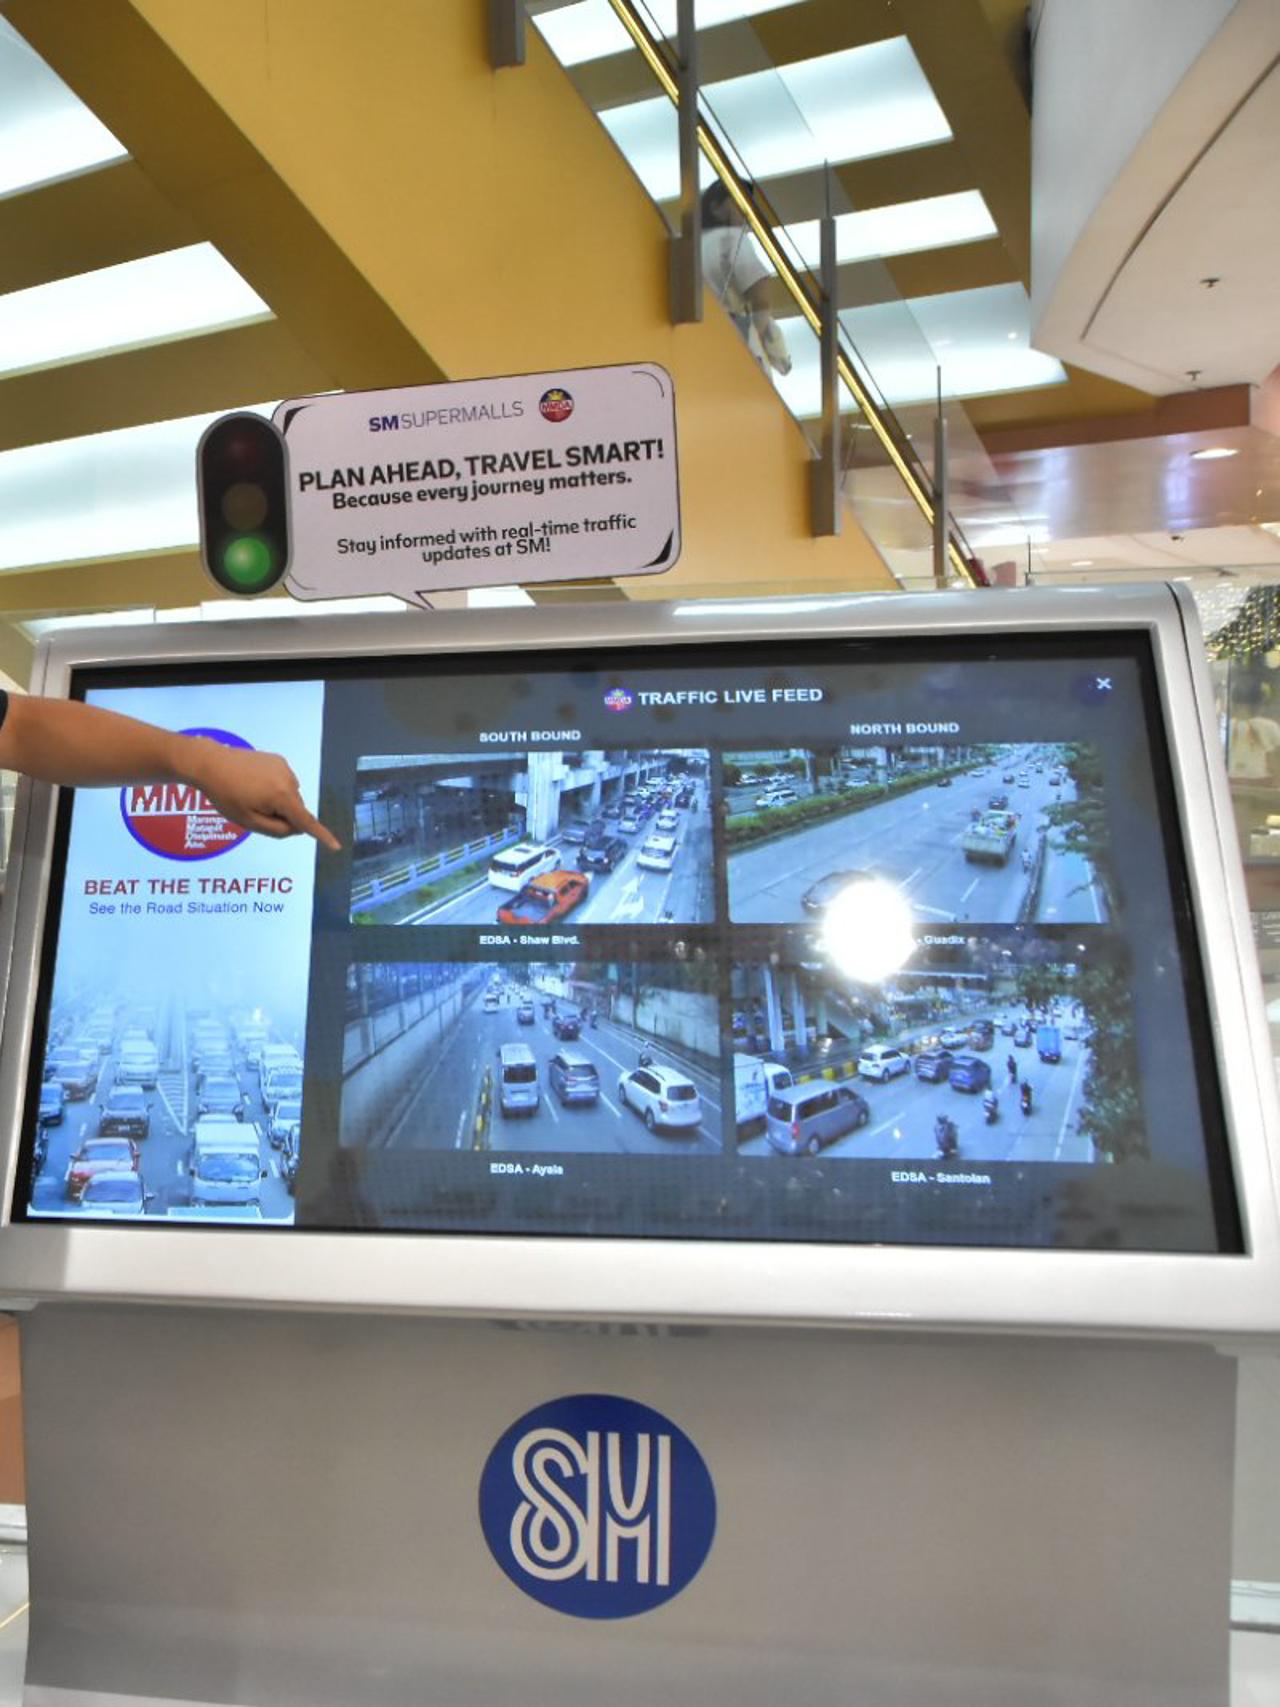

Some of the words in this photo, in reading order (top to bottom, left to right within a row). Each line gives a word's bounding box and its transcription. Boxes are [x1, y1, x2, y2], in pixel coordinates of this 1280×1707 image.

[299, 466, 365, 492] PLAN
[370, 459, 461, 486] AHEAD,
[464, 449, 561, 476] TRAVEL
[565, 438, 664, 467] SMART!
[333, 490, 413, 509] Because
[417, 485, 468, 502] every
[471, 478, 544, 501] journey
[549, 470, 632, 490] matters.
[337, 538, 376, 555] Stay
[380, 529, 456, 550] informed
[459, 525, 497, 543] with
[502, 520, 580, 540] real-time
[583, 513, 637, 532] traffic
[422, 545, 490, 565] updates
[495, 542, 512, 556] at
[516, 537, 551, 554] SM!
[638, 690, 718, 705] TRAFFIC
[724, 689, 766, 704] LIVE
[772, 688, 823, 702] FEED
[479, 731, 527, 743] SOUTH
[531, 730, 581, 742] BOUND
[850, 722, 901, 735] NORTH
[906, 722, 960, 734] BOUND
[84, 879, 140, 895] BEAT
[148, 878, 190, 895] THE
[198, 877, 293, 894] TRAFFIC
[89, 902, 116, 914] See
[121, 902, 141, 914] the
[147, 902, 183, 914] Road
[187, 901, 247, 914] Situation
[253, 901, 284, 913] Now
[479, 935, 511, 945] EDSA
[520, 935, 550, 945] Shaw
[490, 1163, 523, 1174] EDSA
[891, 1171, 927, 1182] EDSA
[936, 1172, 992, 1185] Santolan
[510, 1428, 670, 1586] SM
